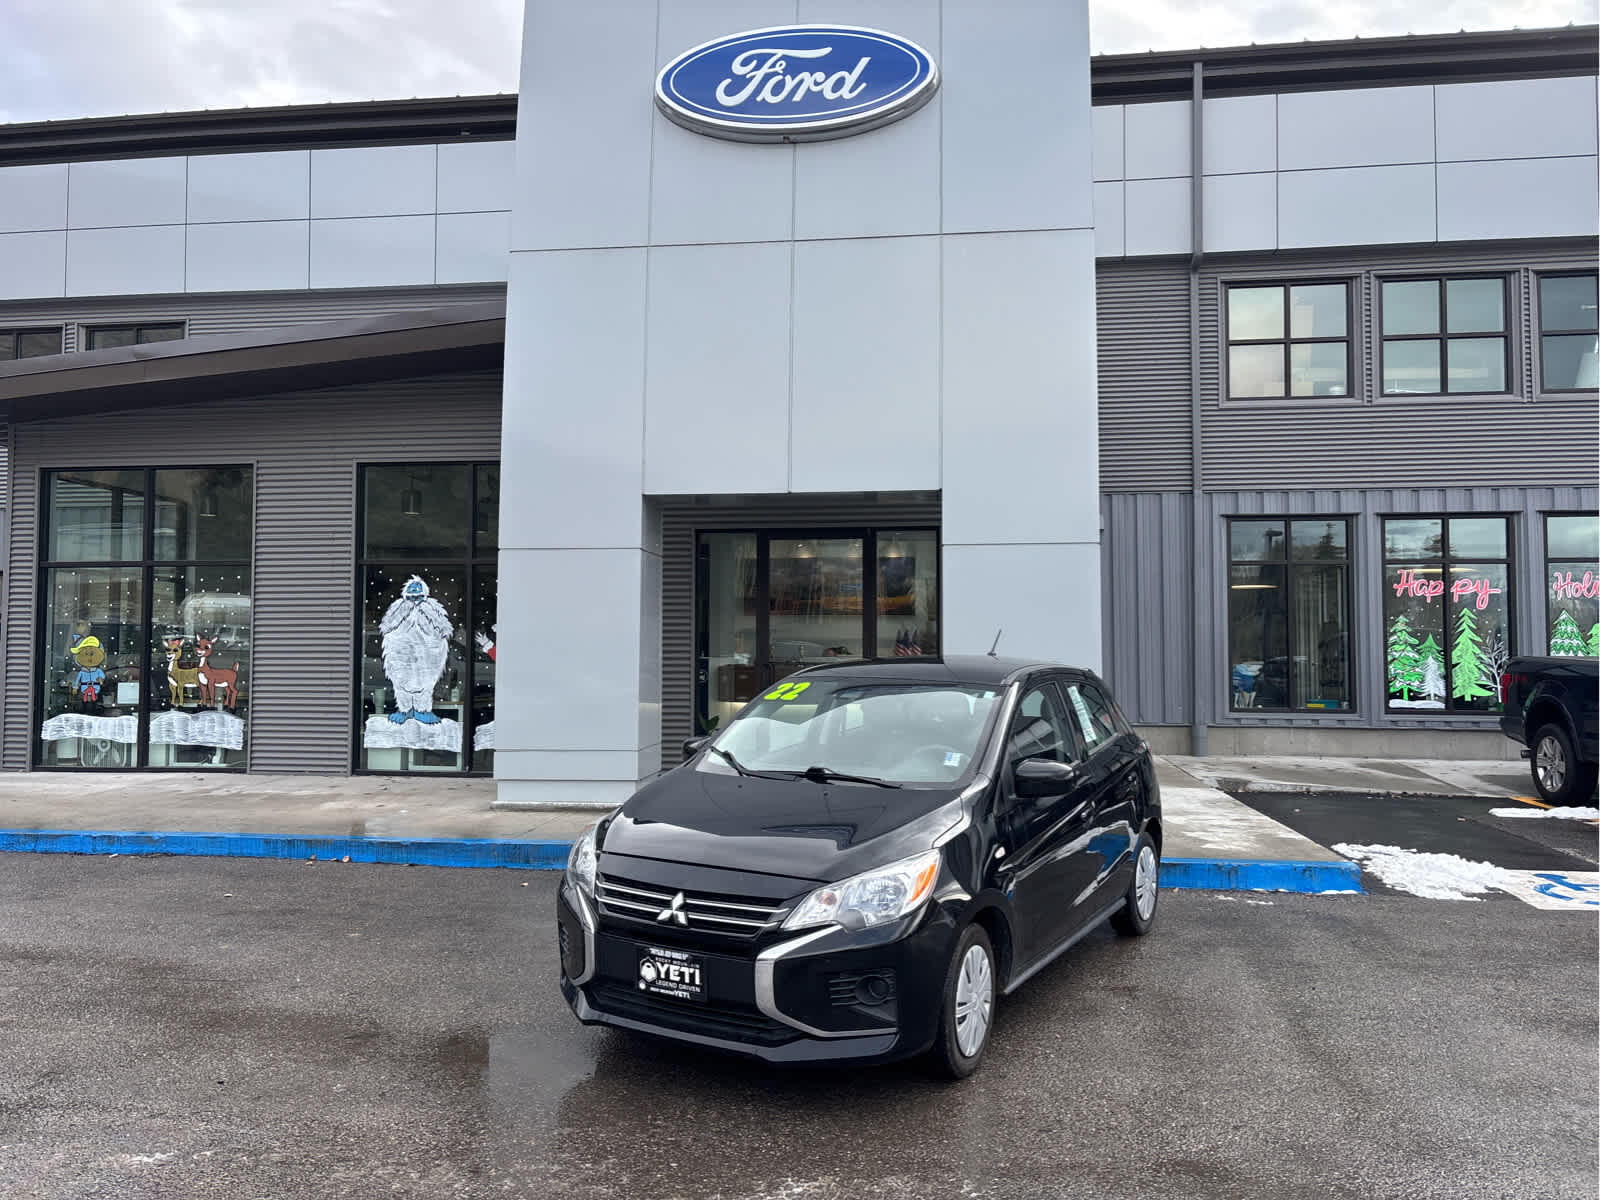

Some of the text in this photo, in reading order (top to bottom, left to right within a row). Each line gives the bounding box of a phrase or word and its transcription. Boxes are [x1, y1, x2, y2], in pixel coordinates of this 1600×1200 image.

[715, 46, 872, 107] Ford
[1393, 568, 1502, 610] Happy
[764, 682, 811, 700] 22
[655, 961, 701, 985] YETI
[655, 979, 678, 988] LEGEND
[678, 983, 701, 992] DRIVEN
